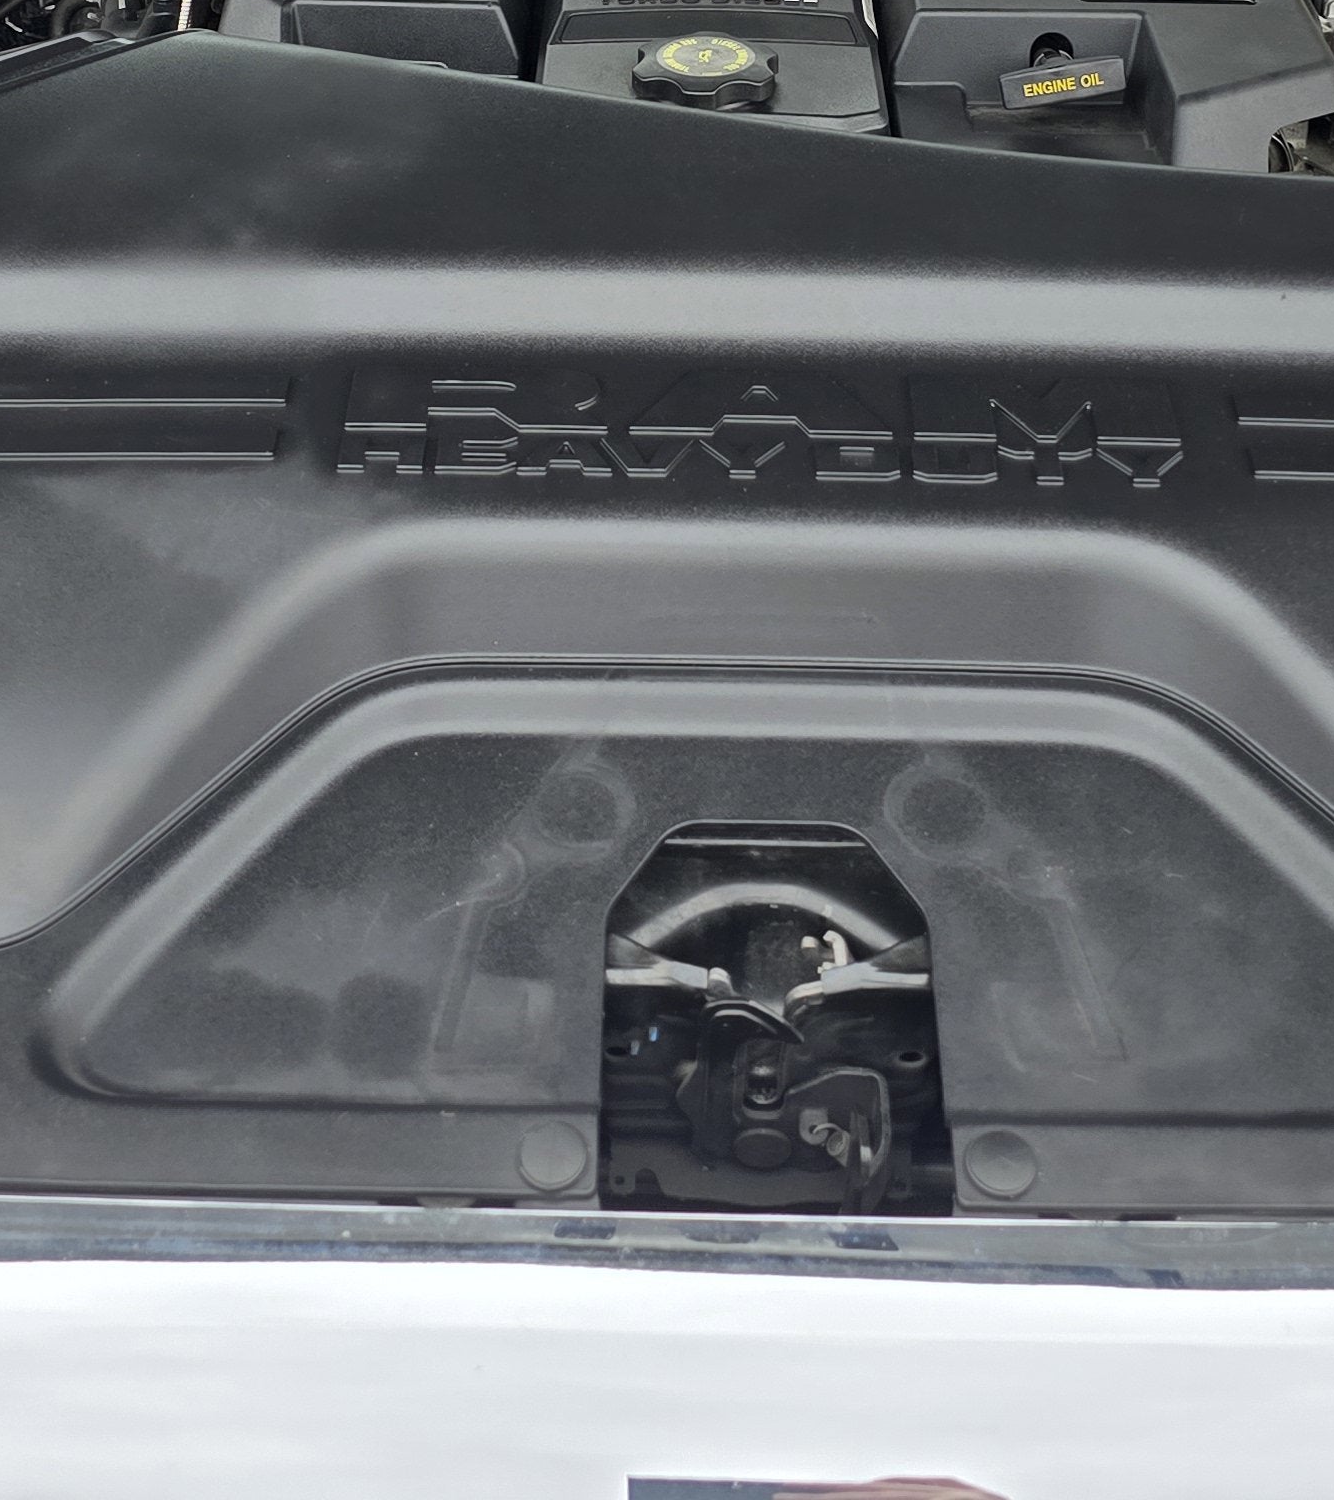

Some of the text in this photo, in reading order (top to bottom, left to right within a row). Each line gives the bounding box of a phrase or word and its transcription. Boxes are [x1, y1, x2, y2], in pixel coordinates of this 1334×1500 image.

[1023, 73, 1105, 97] ENGINE OIL
[343, 370, 1184, 446] RAM
[336, 435, 1184, 488] HEAVY DUTY
